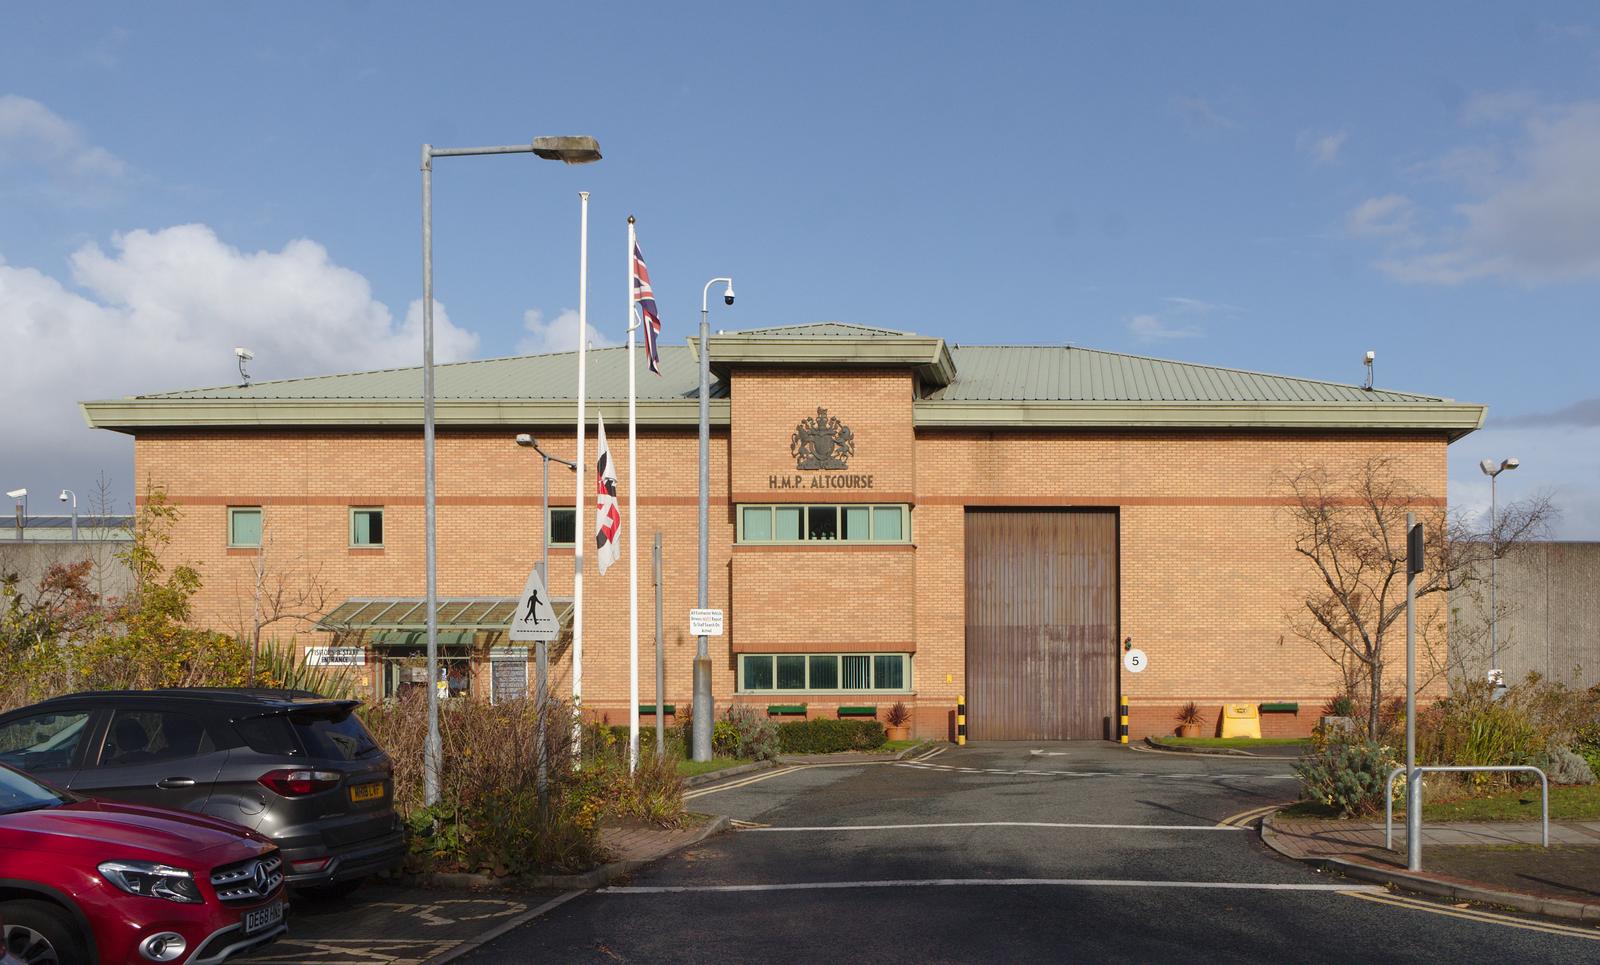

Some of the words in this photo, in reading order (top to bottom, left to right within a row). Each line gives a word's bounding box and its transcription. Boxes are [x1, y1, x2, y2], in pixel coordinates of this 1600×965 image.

[769, 475, 806, 489] H.M.P.
[810, 475, 874, 489] ALTCOURSE
[1132, 657, 1140, 666] 5
[249, 908, 269, 929] DE68
